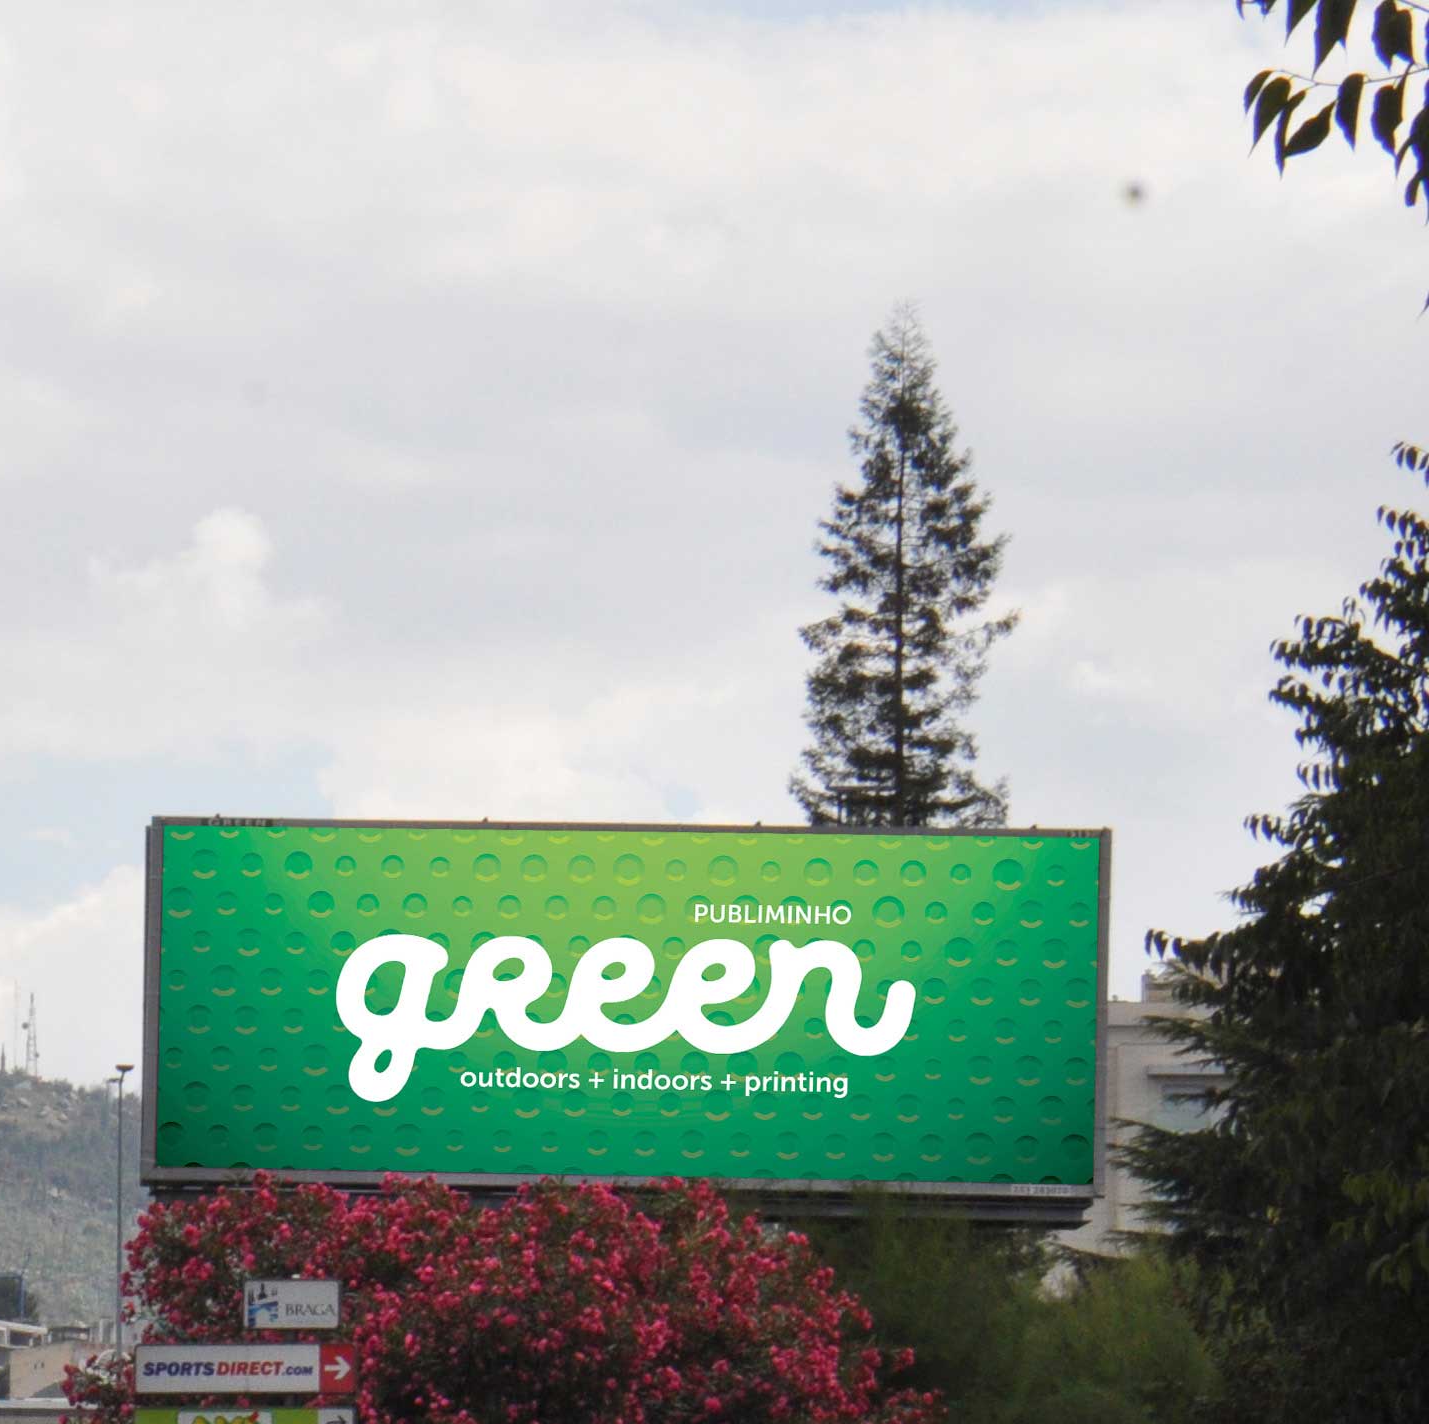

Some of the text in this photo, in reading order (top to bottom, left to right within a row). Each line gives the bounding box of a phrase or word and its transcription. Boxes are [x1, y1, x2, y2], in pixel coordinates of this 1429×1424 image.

[694, 903, 853, 926] PUBLIMINHO
[336, 934, 916, 1102] green
[460, 1067, 580, 1092] outdoors
[612, 1068, 713, 1093] indoors
[744, 1070, 849, 1100] printing
[285, 1303, 336, 1317] BRAGA
